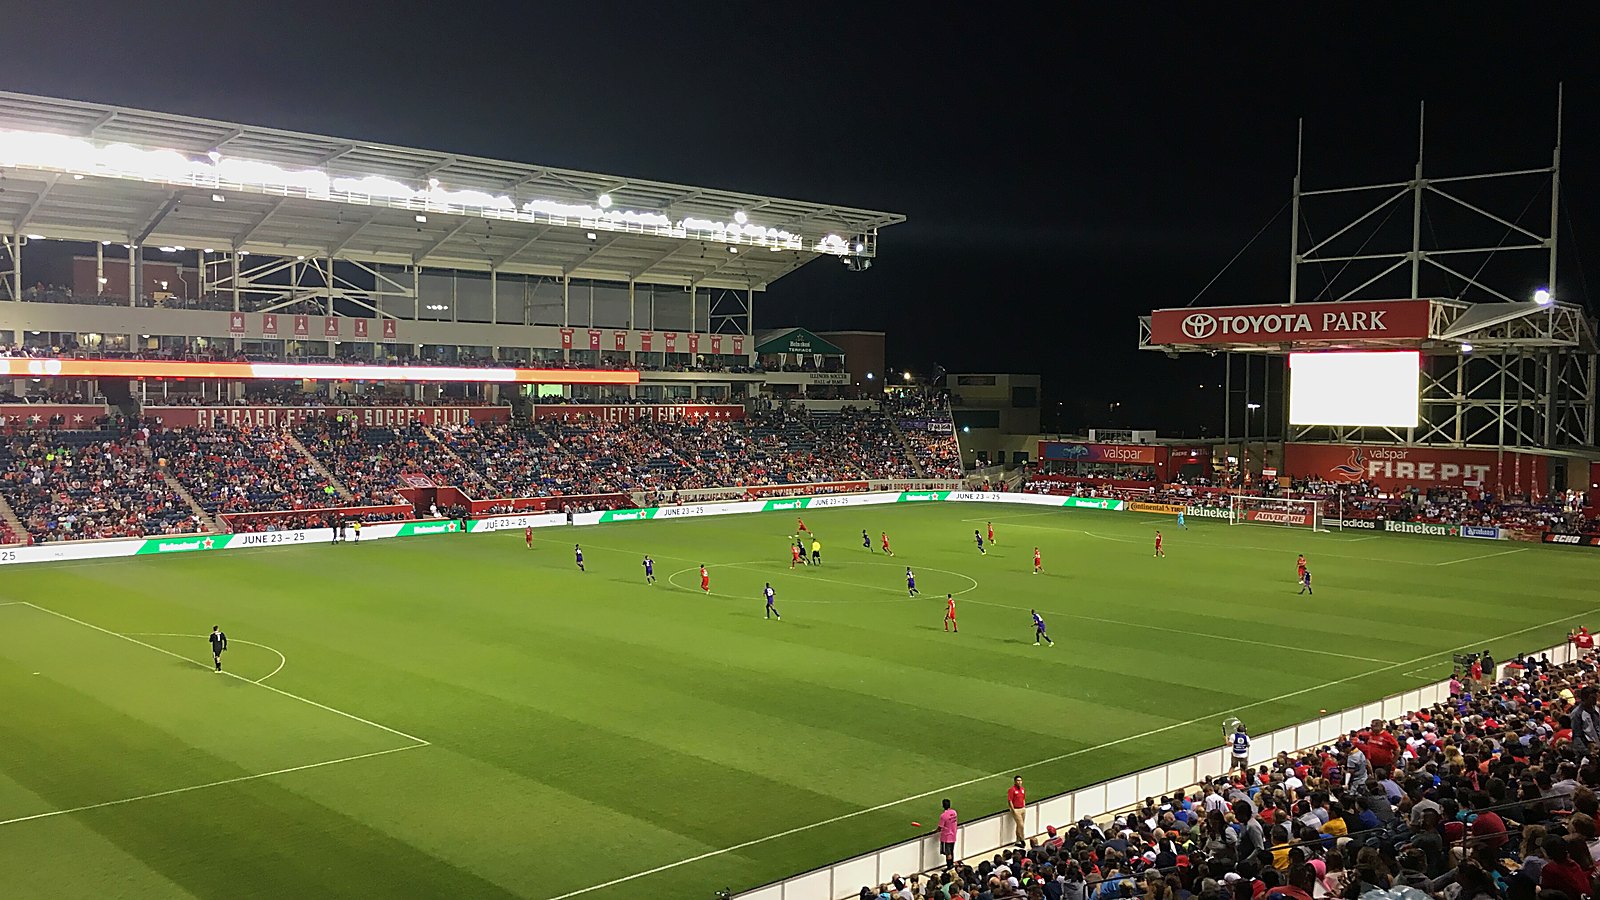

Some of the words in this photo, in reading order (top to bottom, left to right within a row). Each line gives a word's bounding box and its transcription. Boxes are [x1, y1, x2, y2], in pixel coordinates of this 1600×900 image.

[1218, 314, 1313, 334] TOYOTA
[1322, 311, 1387, 331] PARK
[564, 335, 570, 343] 9
[592, 336, 598, 344] 2
[617, 337, 624, 345] 14
[434, 409, 470, 427] CLUB
[603, 407, 635, 421] LET'S
[1103, 446, 1142, 462] valspar
[1369, 447, 1409, 461] valspar
[1368, 460, 1436, 480] FIRE
[1441, 463, 1491, 483] PIT
[663, 507, 680, 516] JUNE
[681, 506, 691, 514] 23
[1130, 502, 1165, 513] Continental
[1187, 506, 1236, 519] Heineken
[500, 519, 510, 527] 23
[518, 518, 527, 526] 25
[1254, 512, 1306, 524] ADVOCARE
[1342, 520, 1375, 529] adidas
[1385, 520, 1446, 536] Heineken
[242, 535, 268, 544] JUNE
[271, 534, 282, 542] 23
[293, 533, 305, 541] 25
[1553, 535, 1581, 544] ECHO
[1, 552, 16, 561] 25
